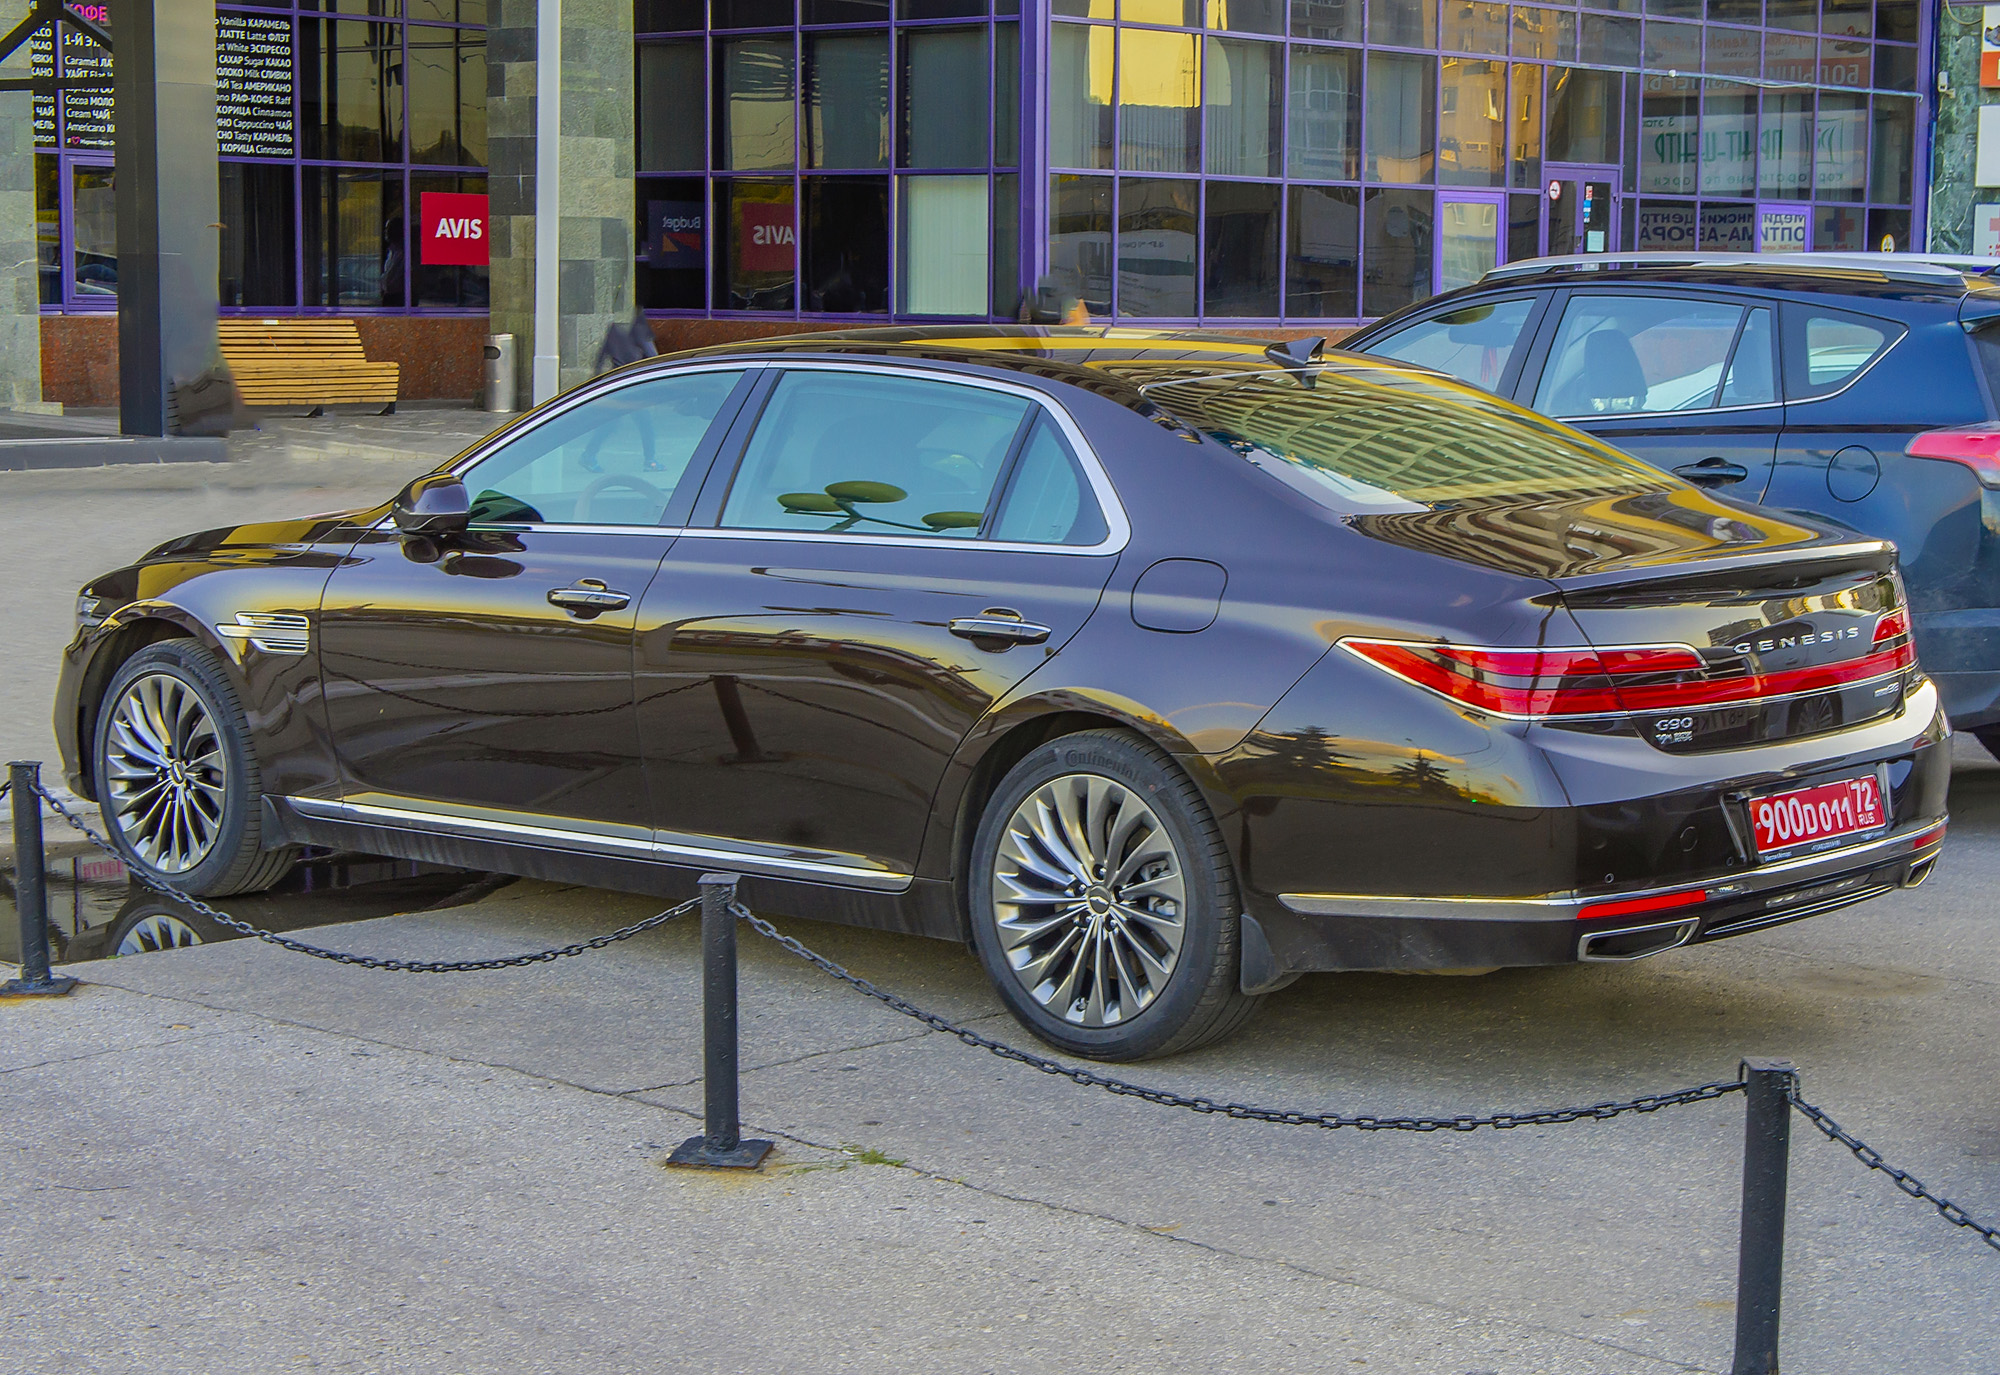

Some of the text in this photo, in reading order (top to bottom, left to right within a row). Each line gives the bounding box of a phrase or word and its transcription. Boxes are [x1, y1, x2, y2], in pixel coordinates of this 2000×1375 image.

[70, 4, 108, 21] ОФЕ
[219, 16, 247, 27] Vanilla
[247, 18, 291, 30] КАРАМЕЛЬ
[219, 29, 291, 43] ЛАТТЕ Latte ФЛЭТ
[225, 42, 250, 53] White
[250, 43, 291, 55] ЭСПРЕССО
[64, 55, 99, 67] Caramel
[218, 54, 292, 68] САХАР Sugar КАКАО
[244, 68, 260, 79] Milk
[260, 69, 292, 80] СЛИВКИ
[230, 80, 243, 90] Tea
[243, 81, 292, 93] АМЕРИКАНО
[65, 94, 89, 105] Cocoa
[230, 93, 274, 105] РАФ-КОФЕ
[35, 105, 56, 117] ЧАЙ
[65, 107, 111, 120] Cream ЧАЙ
[216, 105, 293, 118] КОРИЦА Cinnamon
[65, 121, 107, 133] Americano
[233, 118, 275, 131] Cappuccino
[275, 119, 293, 131] ЧАЙ
[233, 131, 252, 143] Tasty
[252, 132, 293, 143] КАРАМЕЛЬ
[221, 142, 293, 155] КОРИЦА Cinnamon
[435, 218, 482, 239] AVIS
[1733, 627, 1859, 654] GENESIS
[1655, 717, 1693, 731] G90
[1850, 781, 1876, 813] 72
[1857, 811, 1876, 826] RUS
